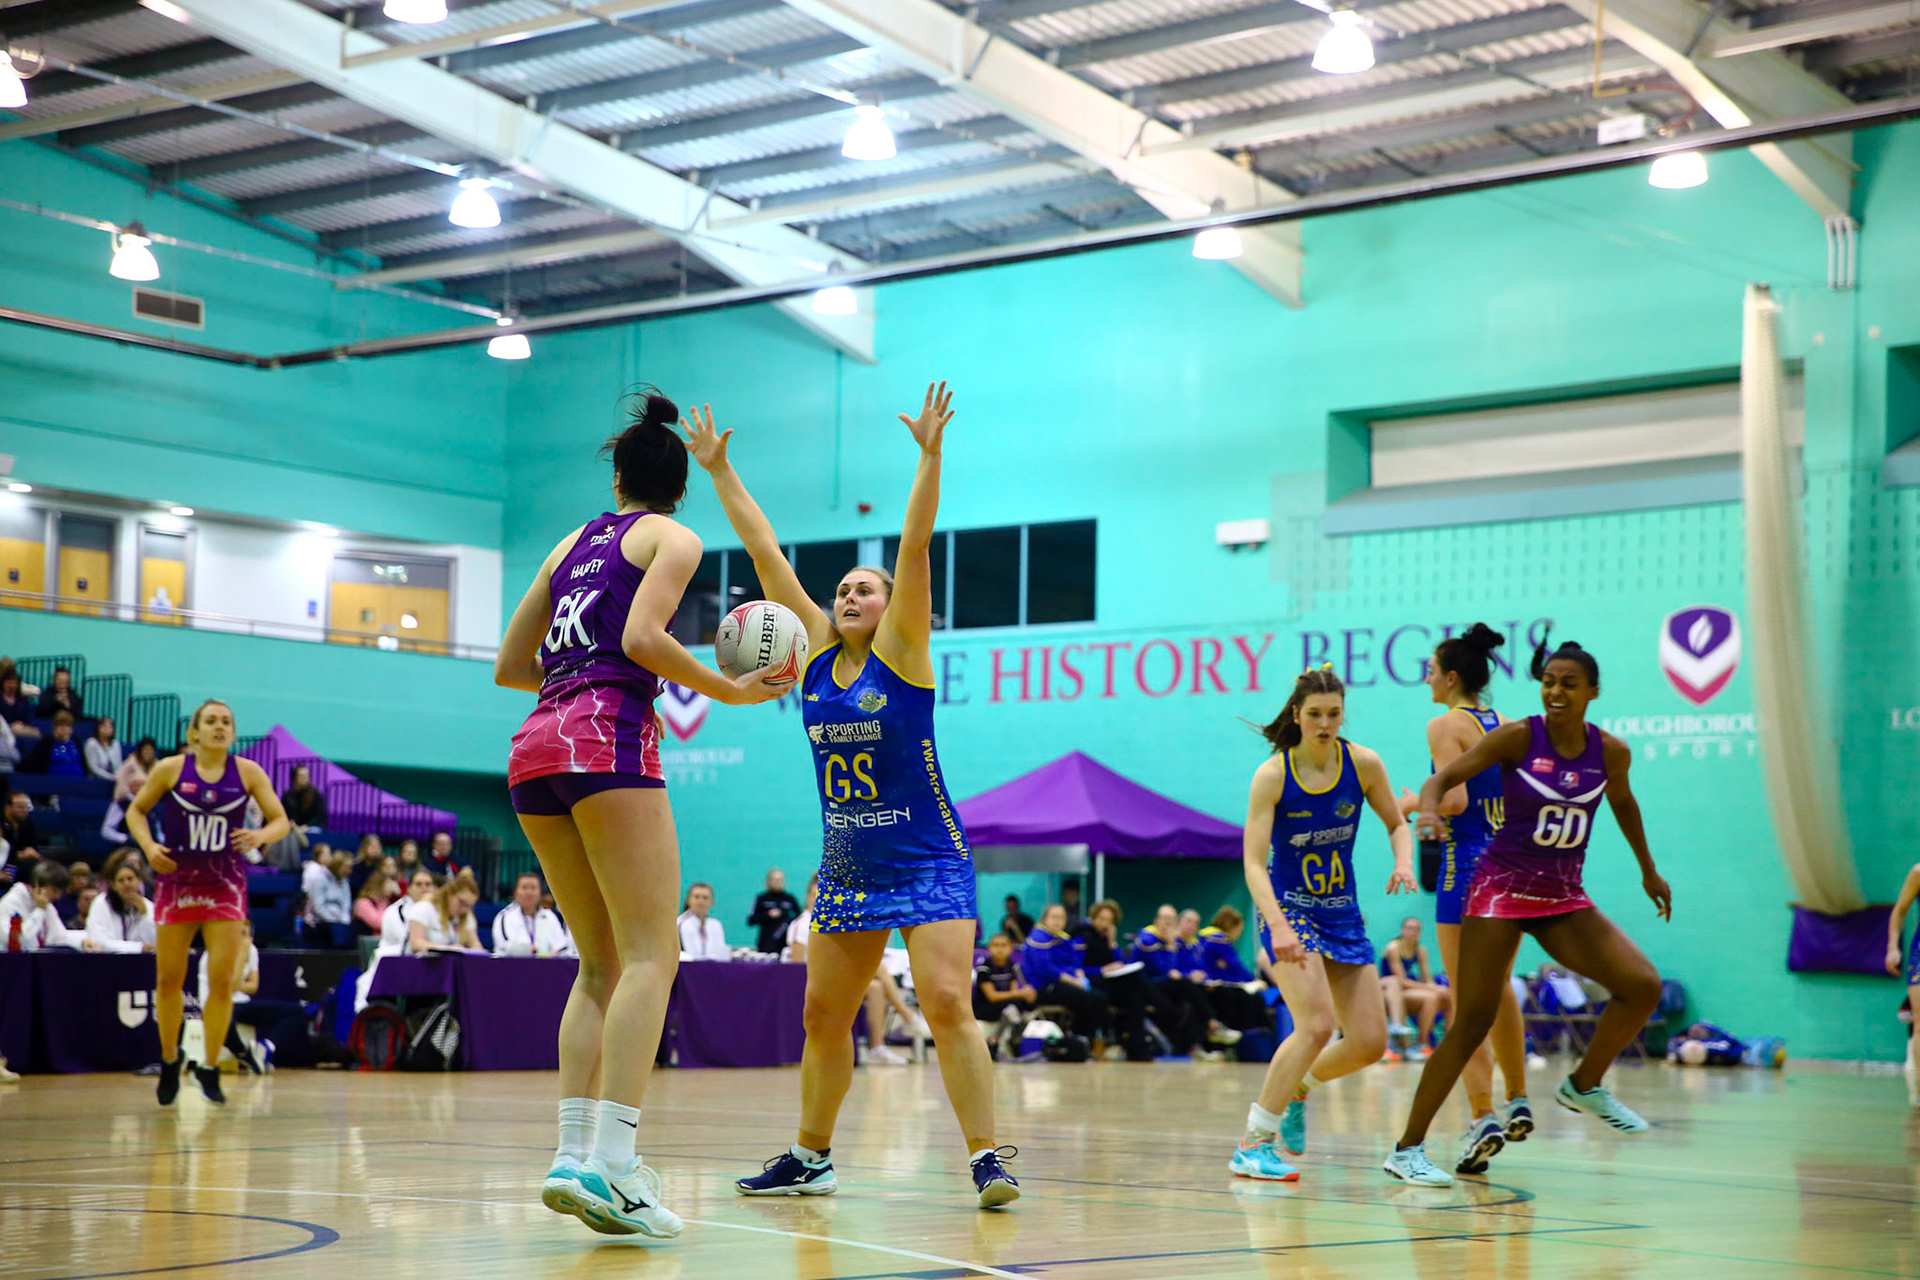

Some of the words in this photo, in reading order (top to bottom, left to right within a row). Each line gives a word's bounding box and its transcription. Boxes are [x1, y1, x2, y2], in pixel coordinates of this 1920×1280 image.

[545, 590, 600, 653] GK
[756, 606, 776, 669] GILBERT
[987, 633, 1275, 705] HISTORY
[1298, 617, 1555, 688] BEGNS
[825, 720, 881, 737] SPORTING
[829, 735, 852, 743] FAMILY
[853, 732, 883, 742] CHANGE
[825, 752, 879, 803] GS
[188, 814, 228, 852] WD
[825, 807, 911, 829] RENGEN
[1532, 804, 1588, 849] GD
[1302, 850, 1345, 895] GA
